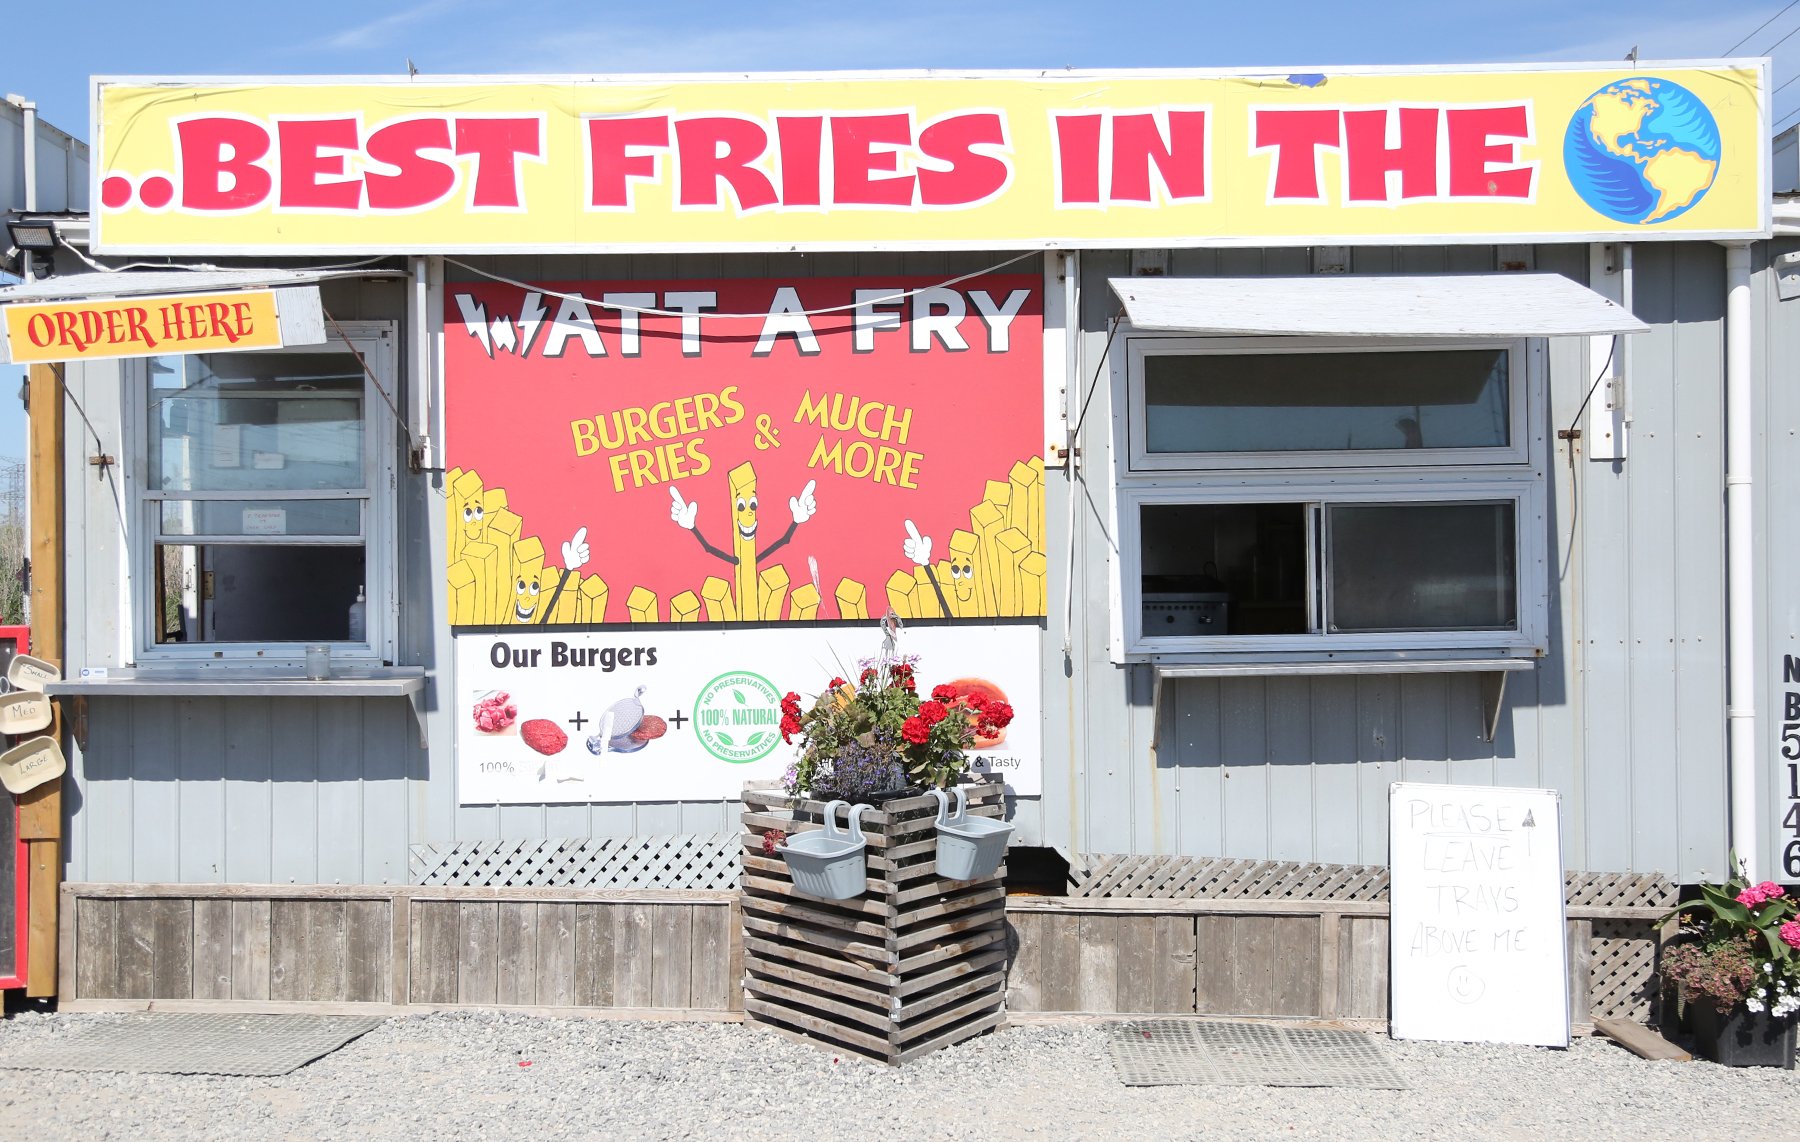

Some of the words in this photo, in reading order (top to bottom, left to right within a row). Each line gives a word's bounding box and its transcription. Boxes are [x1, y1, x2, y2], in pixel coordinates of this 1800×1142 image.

[588, 113, 1008, 211] FRIES
[1055, 110, 1206, 203] IN
[1254, 105, 1534, 202] THE
[27, 307, 158, 353] ORDER
[158, 302, 254, 344] HERE
[454, 291, 718, 359] WATT
[752, 286, 822, 357] A
[852, 288, 1032, 354] FRY
[570, 386, 746, 457] BURGERS
[753, 413, 781, 451] &
[793, 388, 913, 445] MUCH
[608, 437, 712, 493] FRIES
[807, 433, 925, 490] MORE
[490, 641, 542, 669] Our
[551, 641, 658, 673] Burgers
[703, 691, 715, 706] NO
[713, 677, 776, 705] PRESERVATIVES
[700, 708, 730, 727] 100%
[732, 708, 779, 726] NATURAL
[702, 729, 714, 743] NO
[712, 732, 776, 758] PRESERVATIVES
[479, 761, 515, 773] 100%
[974, 755, 984, 768] &
[987, 756, 1021, 770] Tasty
[1407, 799, 1513, 833] PLEASE
[1422, 840, 1514, 873] LEAVE
[1426, 883, 1519, 914] TRAYS
[1410, 921, 1478, 958] ABOVE
[1492, 926, 1529, 953] ME
